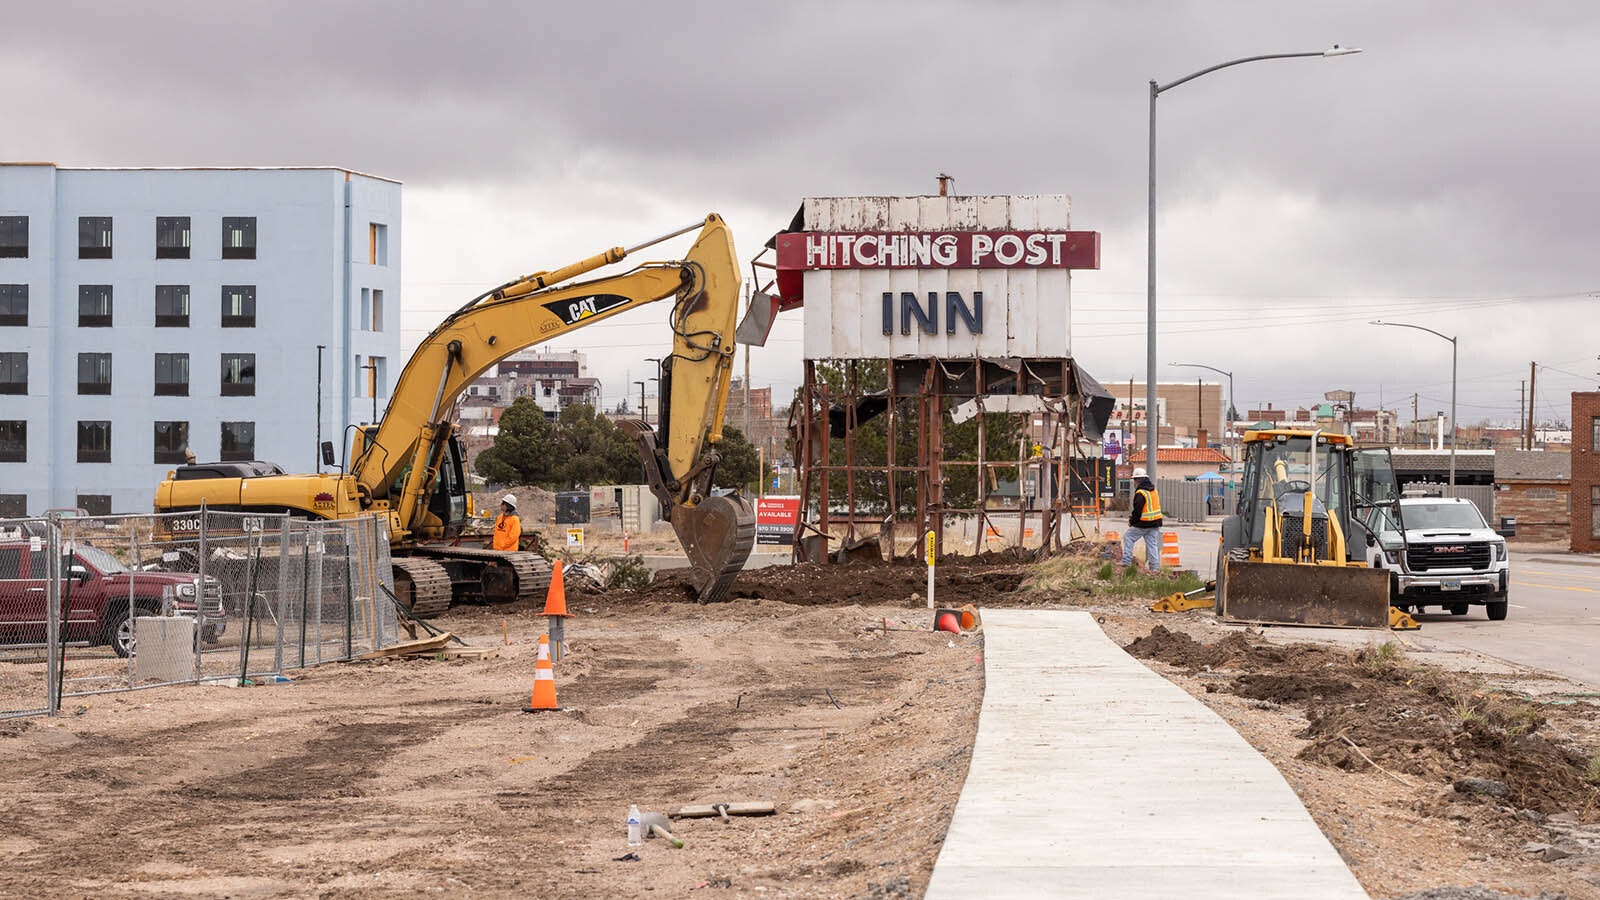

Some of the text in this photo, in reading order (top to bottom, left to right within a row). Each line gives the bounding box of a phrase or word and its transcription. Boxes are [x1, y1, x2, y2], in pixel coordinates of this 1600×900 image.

[806, 234, 1067, 266] HITCHING POST
[568, 297, 597, 321] CAT
[882, 291, 983, 336] INN
[173, 518, 200, 531] 330C
[243, 516, 265, 531] CAT
[1433, 545, 1465, 553] GMC
